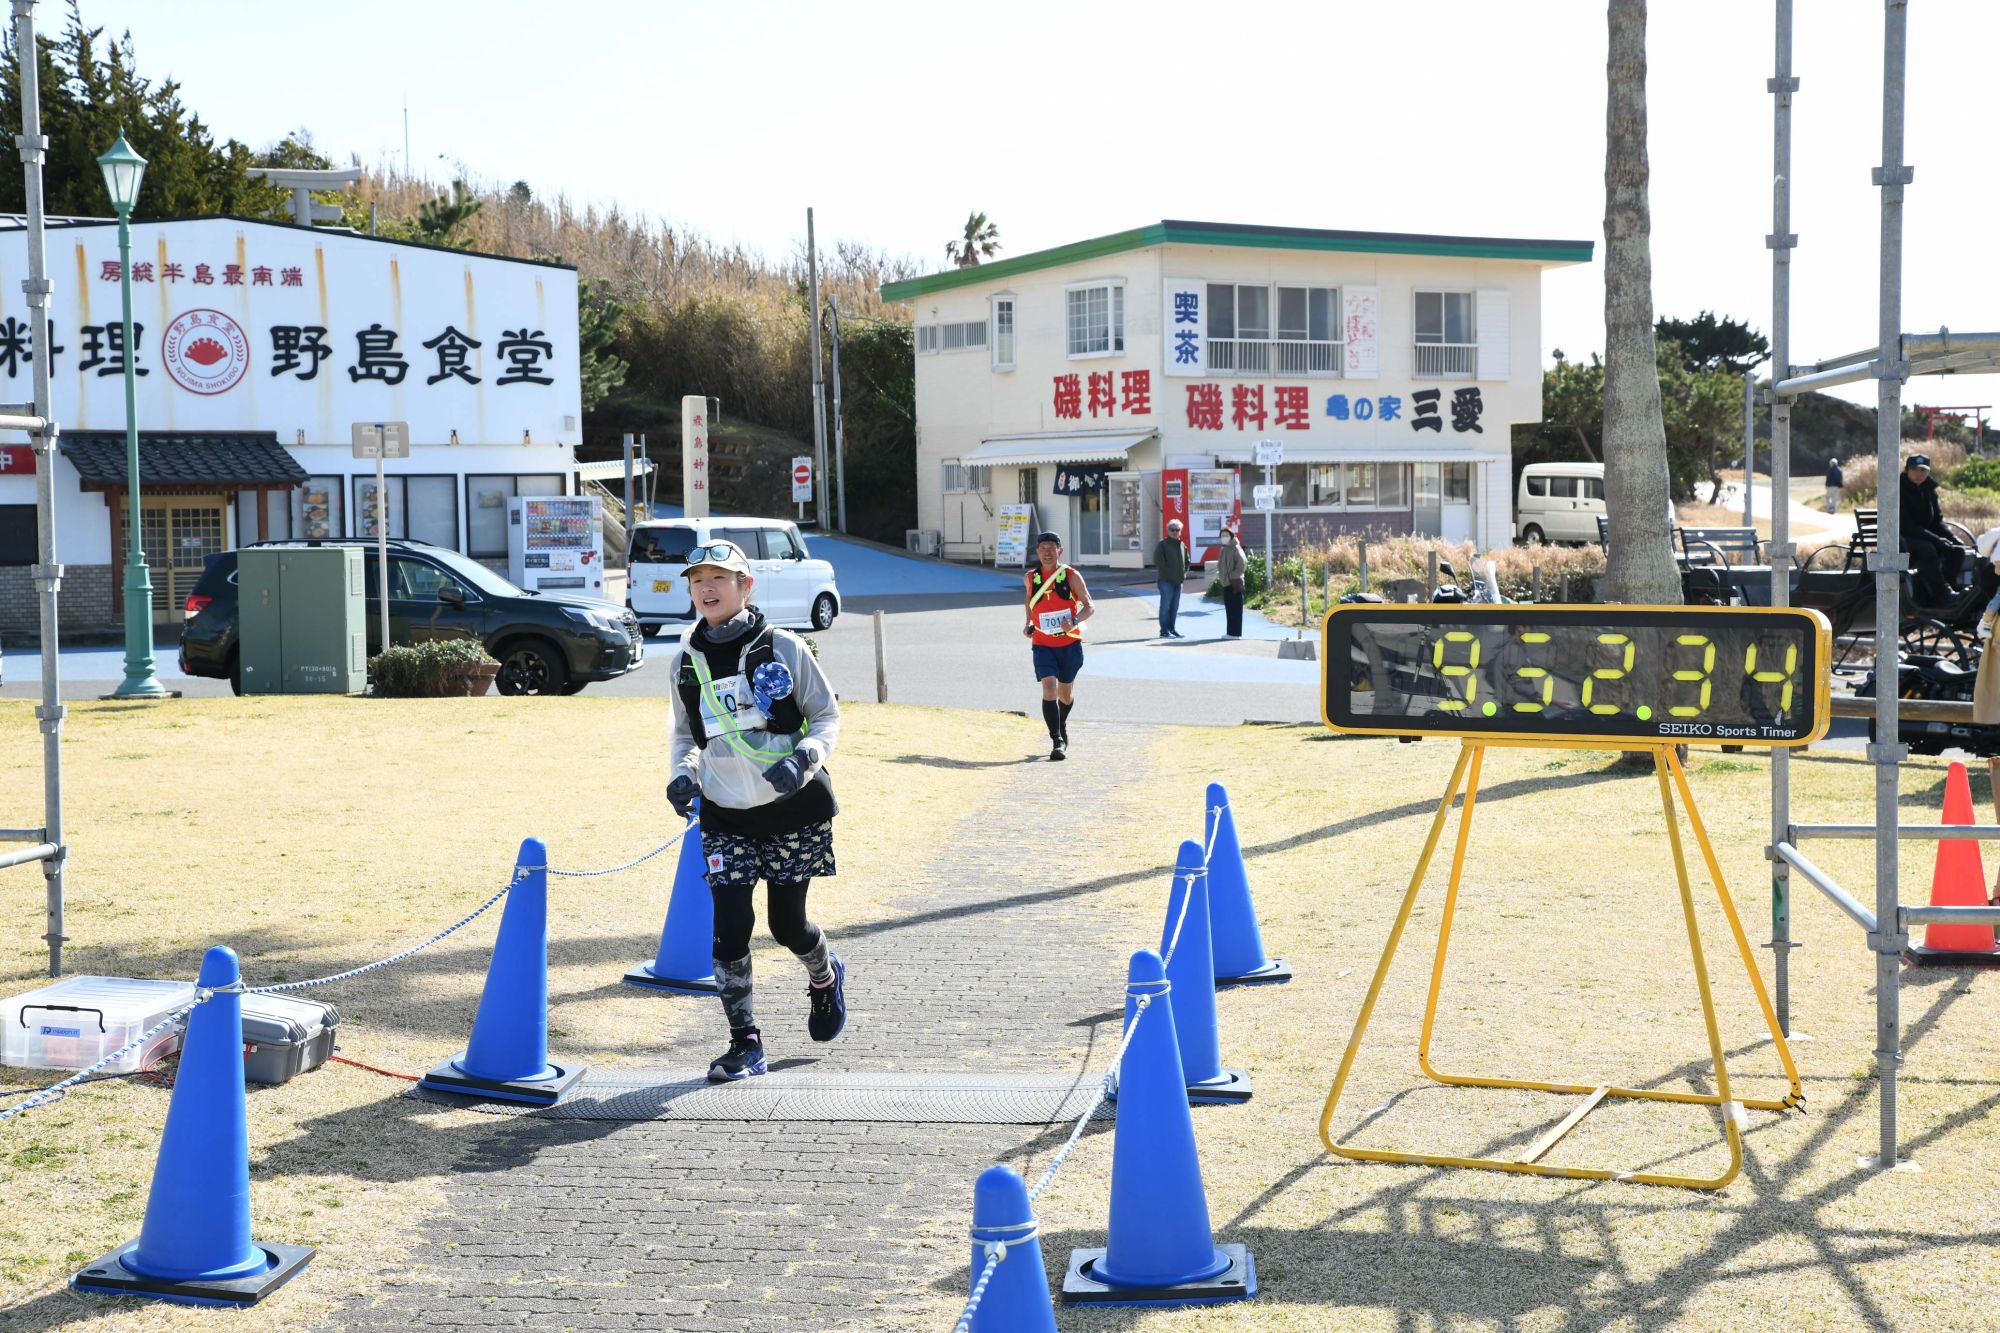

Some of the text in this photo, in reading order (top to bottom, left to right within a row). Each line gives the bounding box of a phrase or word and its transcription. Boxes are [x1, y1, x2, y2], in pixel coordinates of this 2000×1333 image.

[100, 261, 303, 287] 房総半島最南端
[270, 323, 555, 386] 野島食堂
[176, 366, 239, 390] NOJIMA SHOKUDO
[1053, 369, 1151, 420] 磯料理
[1186, 383, 1310, 431] 磯料理
[1326, 394, 1401, 421] 亀の家
[1659, 723, 1797, 737] SEIKO Sports Timer
